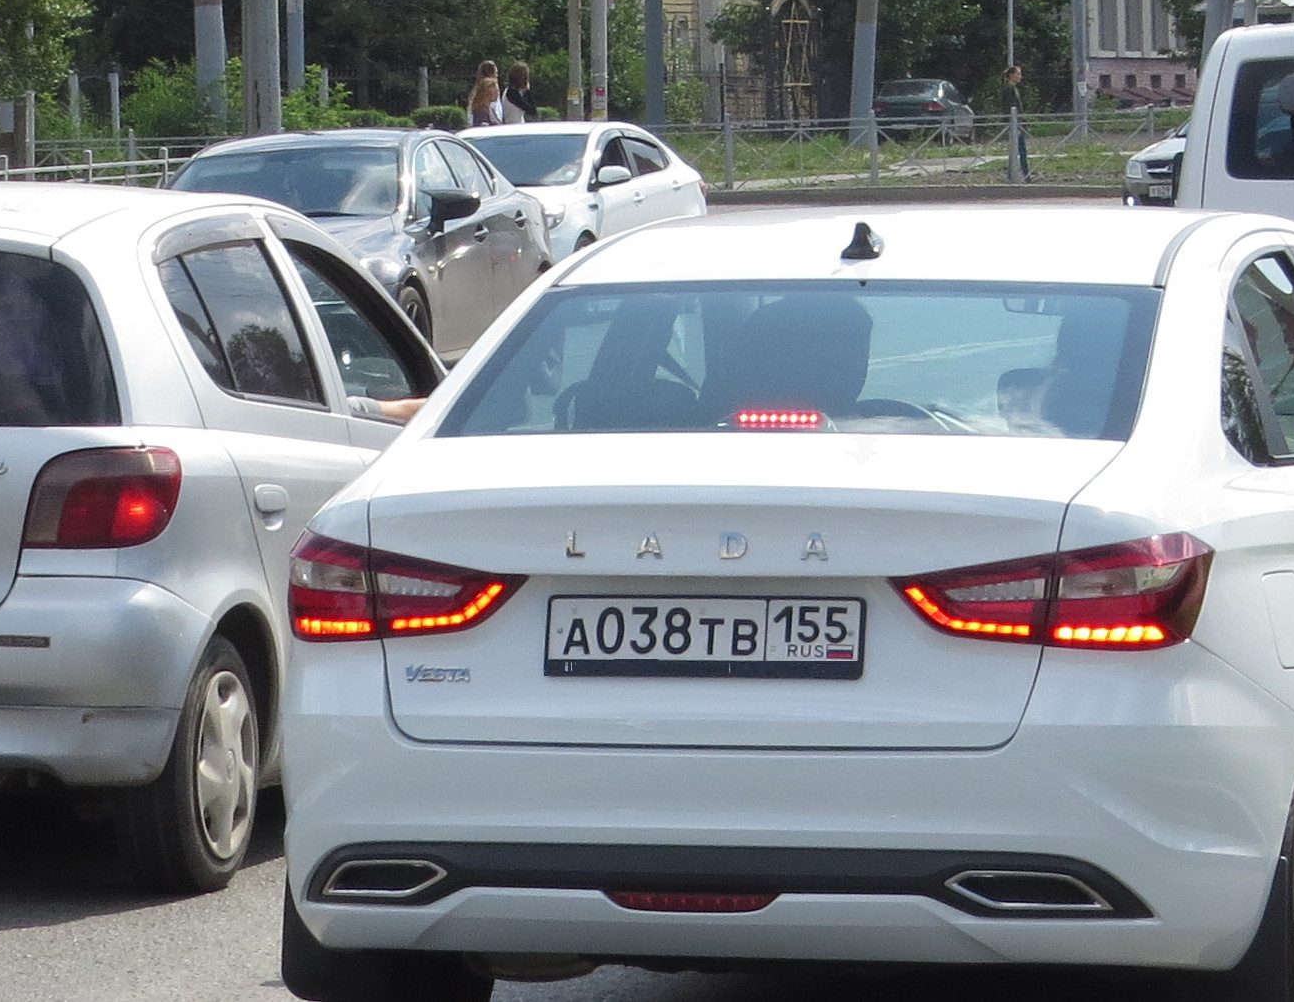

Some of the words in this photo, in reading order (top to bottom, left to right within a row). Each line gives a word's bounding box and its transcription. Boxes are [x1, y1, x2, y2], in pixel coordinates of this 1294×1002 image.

[566, 531, 829, 560] LADA
[563, 607, 759, 656] А038ТВ
[773, 606, 848, 644] 155
[787, 643, 825, 659] RUS
